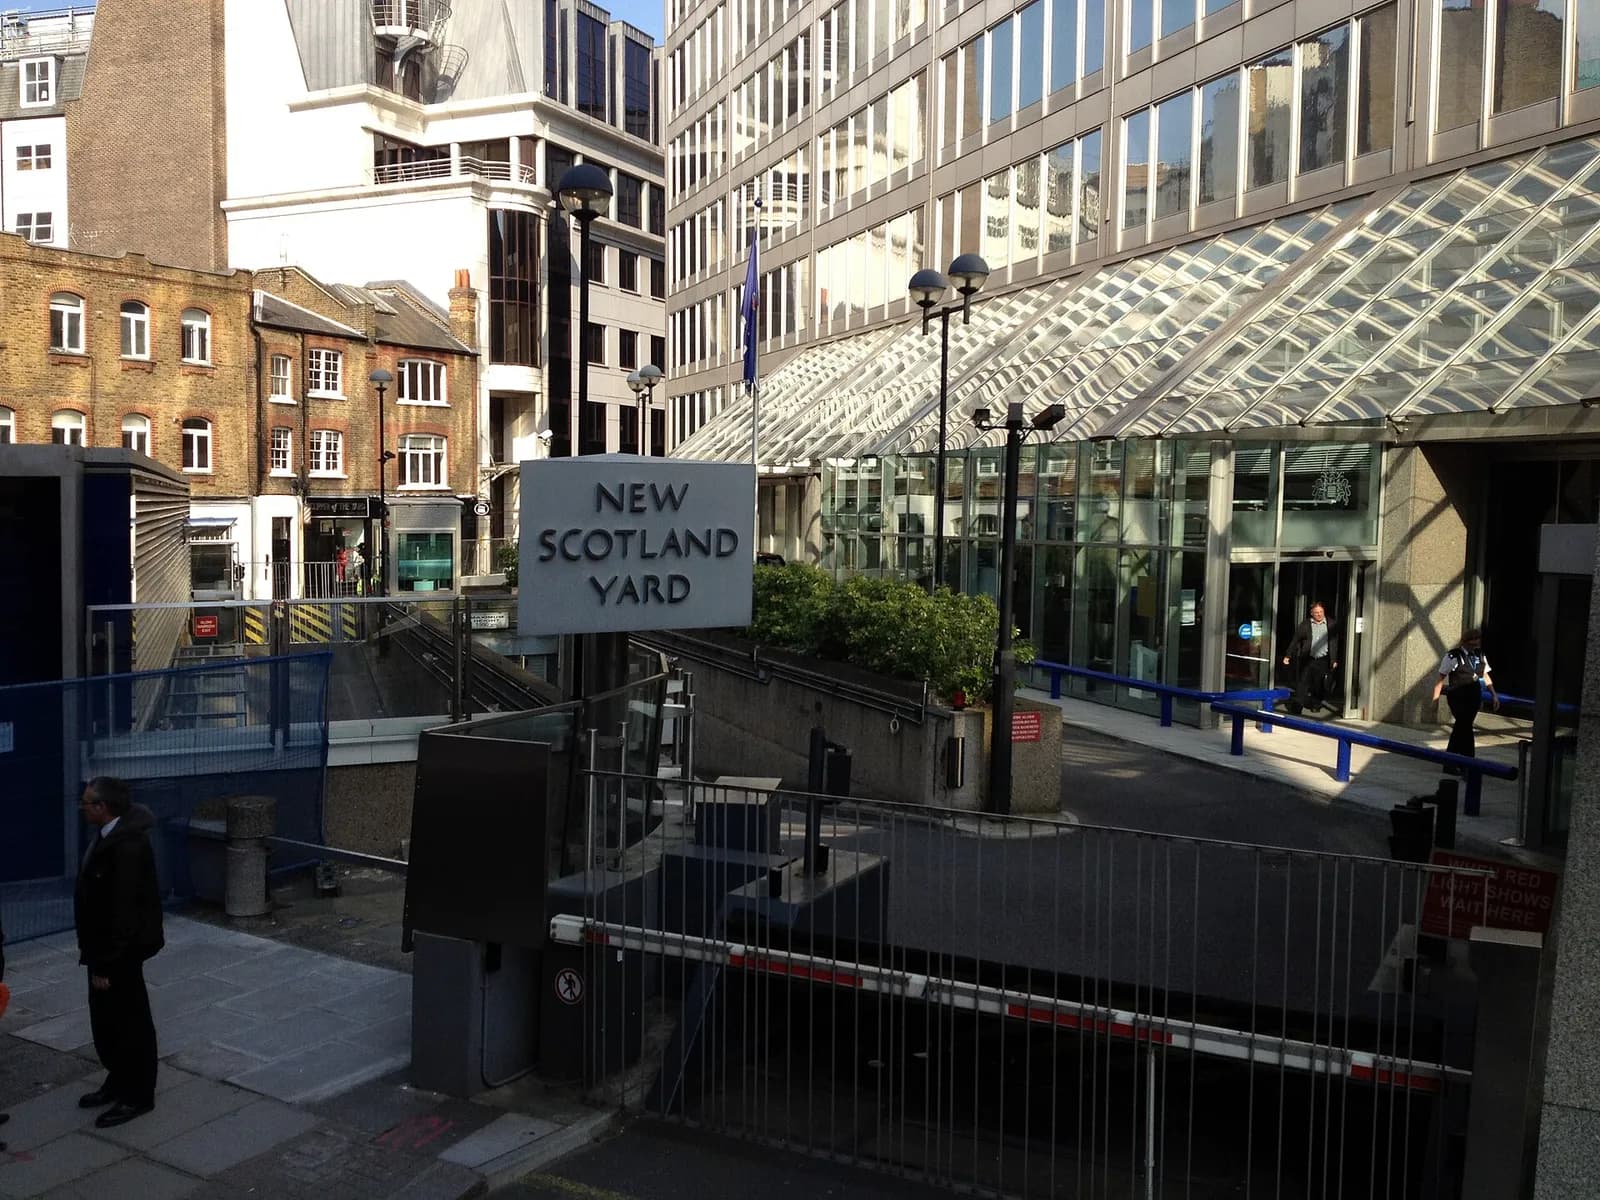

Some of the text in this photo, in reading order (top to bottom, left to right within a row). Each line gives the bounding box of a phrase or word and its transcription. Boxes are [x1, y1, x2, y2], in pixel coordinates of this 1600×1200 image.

[595, 482, 689, 513] NEW
[539, 527, 739, 562] SCOTLAND
[589, 574, 691, 606] YARD
[1431, 874, 1550, 909] LIGHT SHOWS
[1505, 869, 1541, 889] RED
[1440, 896, 1483, 915] WAIT
[1487, 904, 1537, 926] HERE
